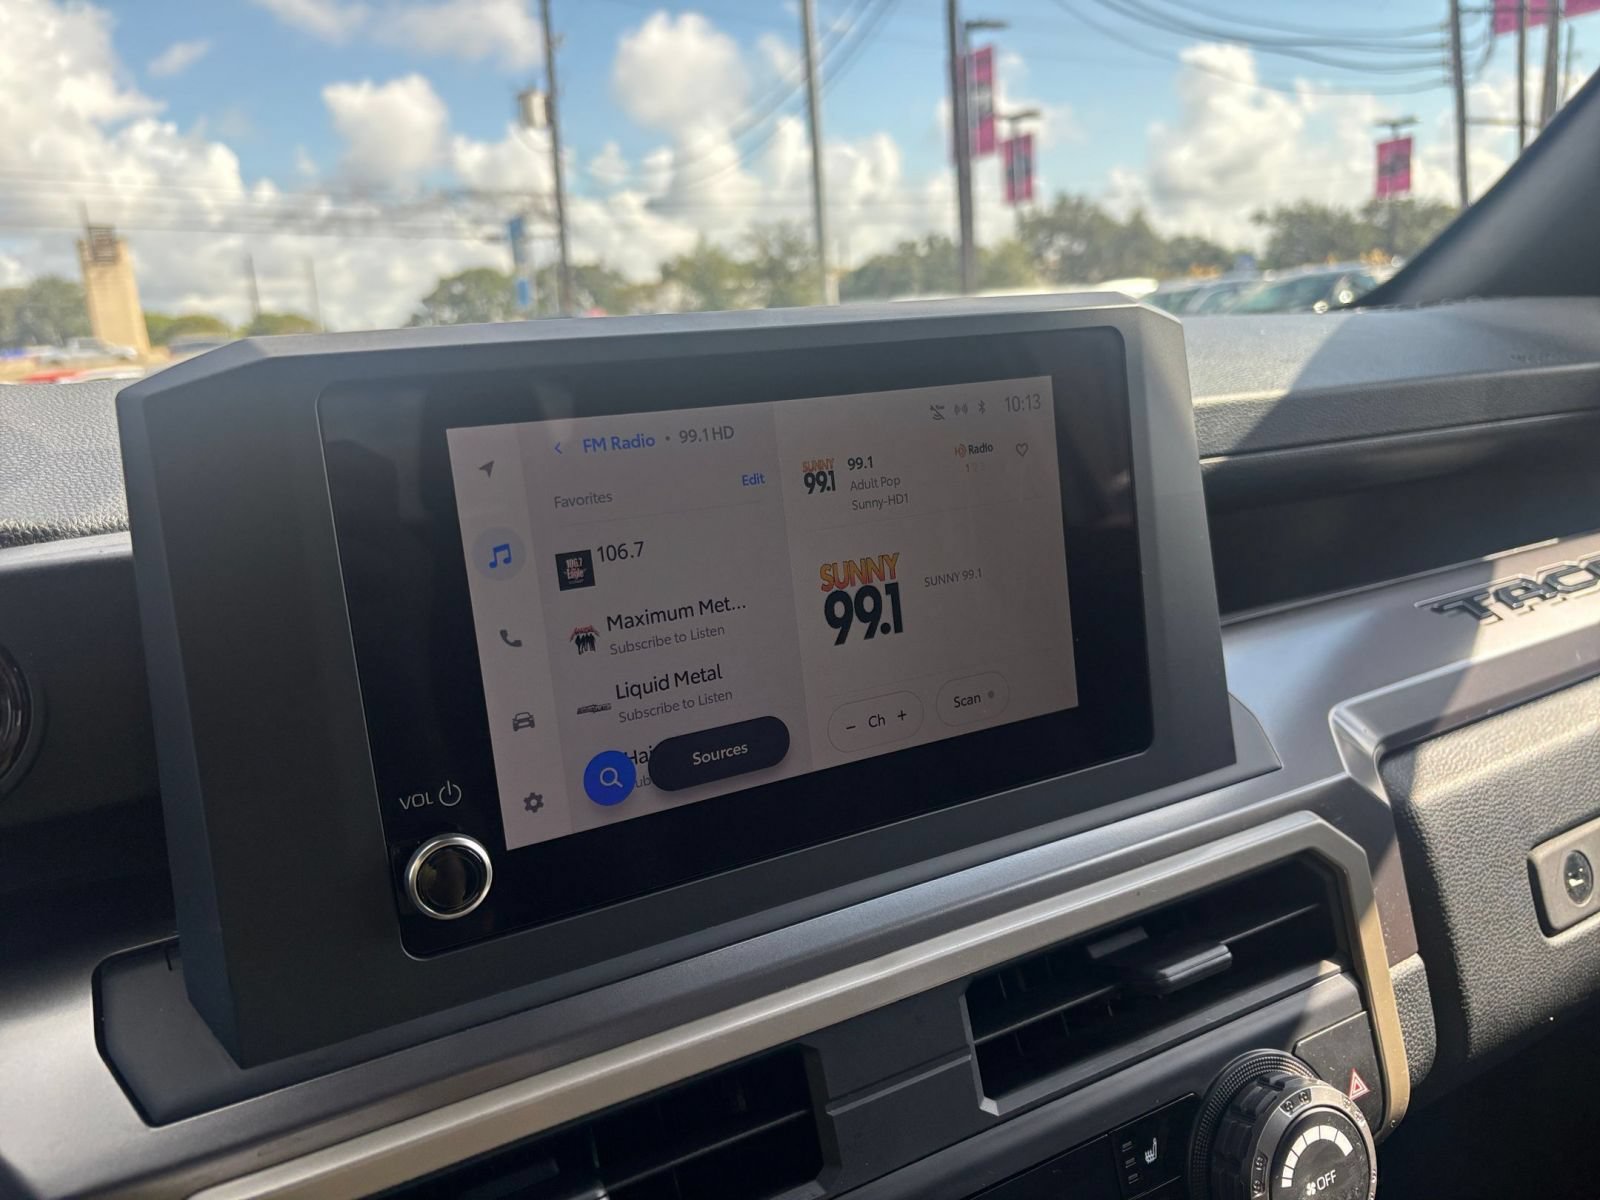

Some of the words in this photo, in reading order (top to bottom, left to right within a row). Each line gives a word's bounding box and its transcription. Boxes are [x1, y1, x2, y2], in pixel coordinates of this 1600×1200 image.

[1004, 394, 1041, 413] 10:13
[583, 438, 607, 453] FM
[611, 434, 656, 450] Radio
[968, 443, 994, 456] Radio
[801, 458, 835, 473] SUNNY
[847, 456, 874, 471] 99.1
[741, 472, 766, 486] Edit
[803, 471, 836, 494] 99.1
[850, 478, 879, 491] Adult
[880, 476, 901, 490] Pop
[553, 491, 613, 509] Favorites
[851, 493, 909, 511] Sunny-HD1
[597, 541, 645, 562] 106.7
[819, 552, 900, 592] SUNNY
[924, 571, 962, 587] SUNNY
[962, 568, 983, 582] 99.1
[606, 605, 695, 632] Maximum
[824, 582, 904, 646] 99.1
[609, 634, 672, 656] Subscribe
[674, 632, 687, 644] to
[690, 625, 726, 641] Listen
[616, 674, 670, 700] Liquid
[674, 664, 723, 688] Metal
[618, 701, 680, 723] Subscribe
[682, 698, 695, 710] to
[698, 690, 733, 706] Listen
[953, 693, 981, 708] Scan
[868, 713, 886, 728] Ch
[692, 744, 749, 766] Sources
[399, 792, 434, 810] VOL
[1316, 1169, 1337, 1191] OFF
